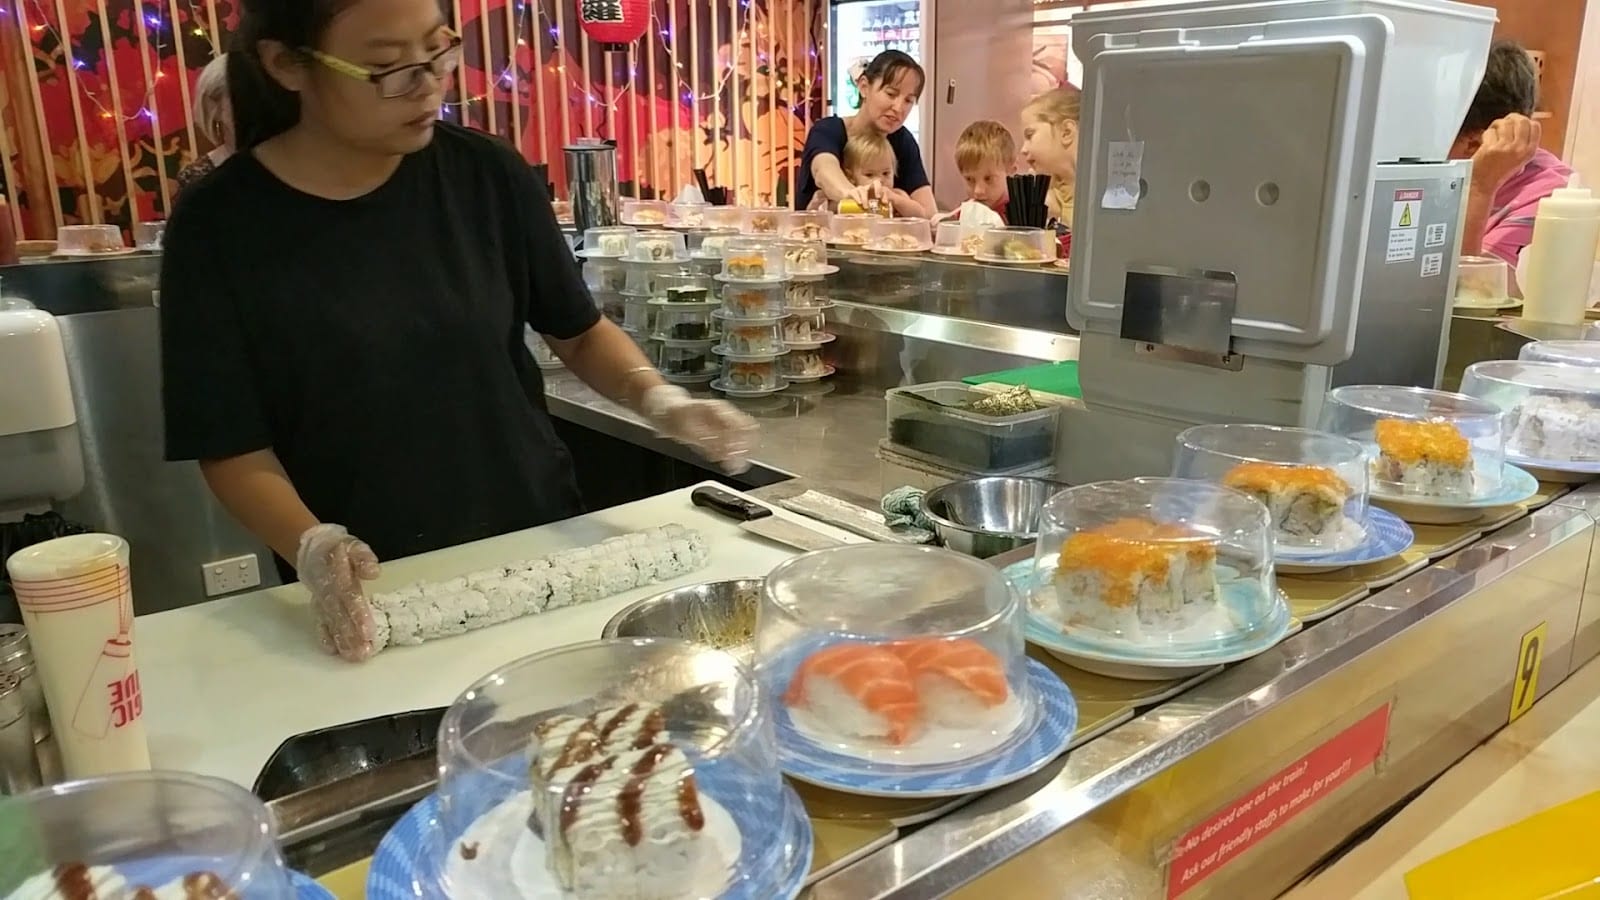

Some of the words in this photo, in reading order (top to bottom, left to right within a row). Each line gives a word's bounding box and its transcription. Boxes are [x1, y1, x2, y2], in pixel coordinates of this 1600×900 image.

[1517, 636, 1539, 710] 9
[1180, 861, 1200, 884] Ask
[1201, 851, 1218, 869] our
[1217, 826, 1254, 862] friendly
[1253, 809, 1278, 834] staffs
[1279, 804, 1289, 817] to
[1289, 788, 1312, 809] make
[1311, 778, 1325, 797] for
[1201, 808, 1236, 842] desired
[1236, 799, 1254, 818] one
[1254, 791, 1267, 806] on
[1267, 781, 1282, 797] the
[1283, 760, 1308, 787] train?
